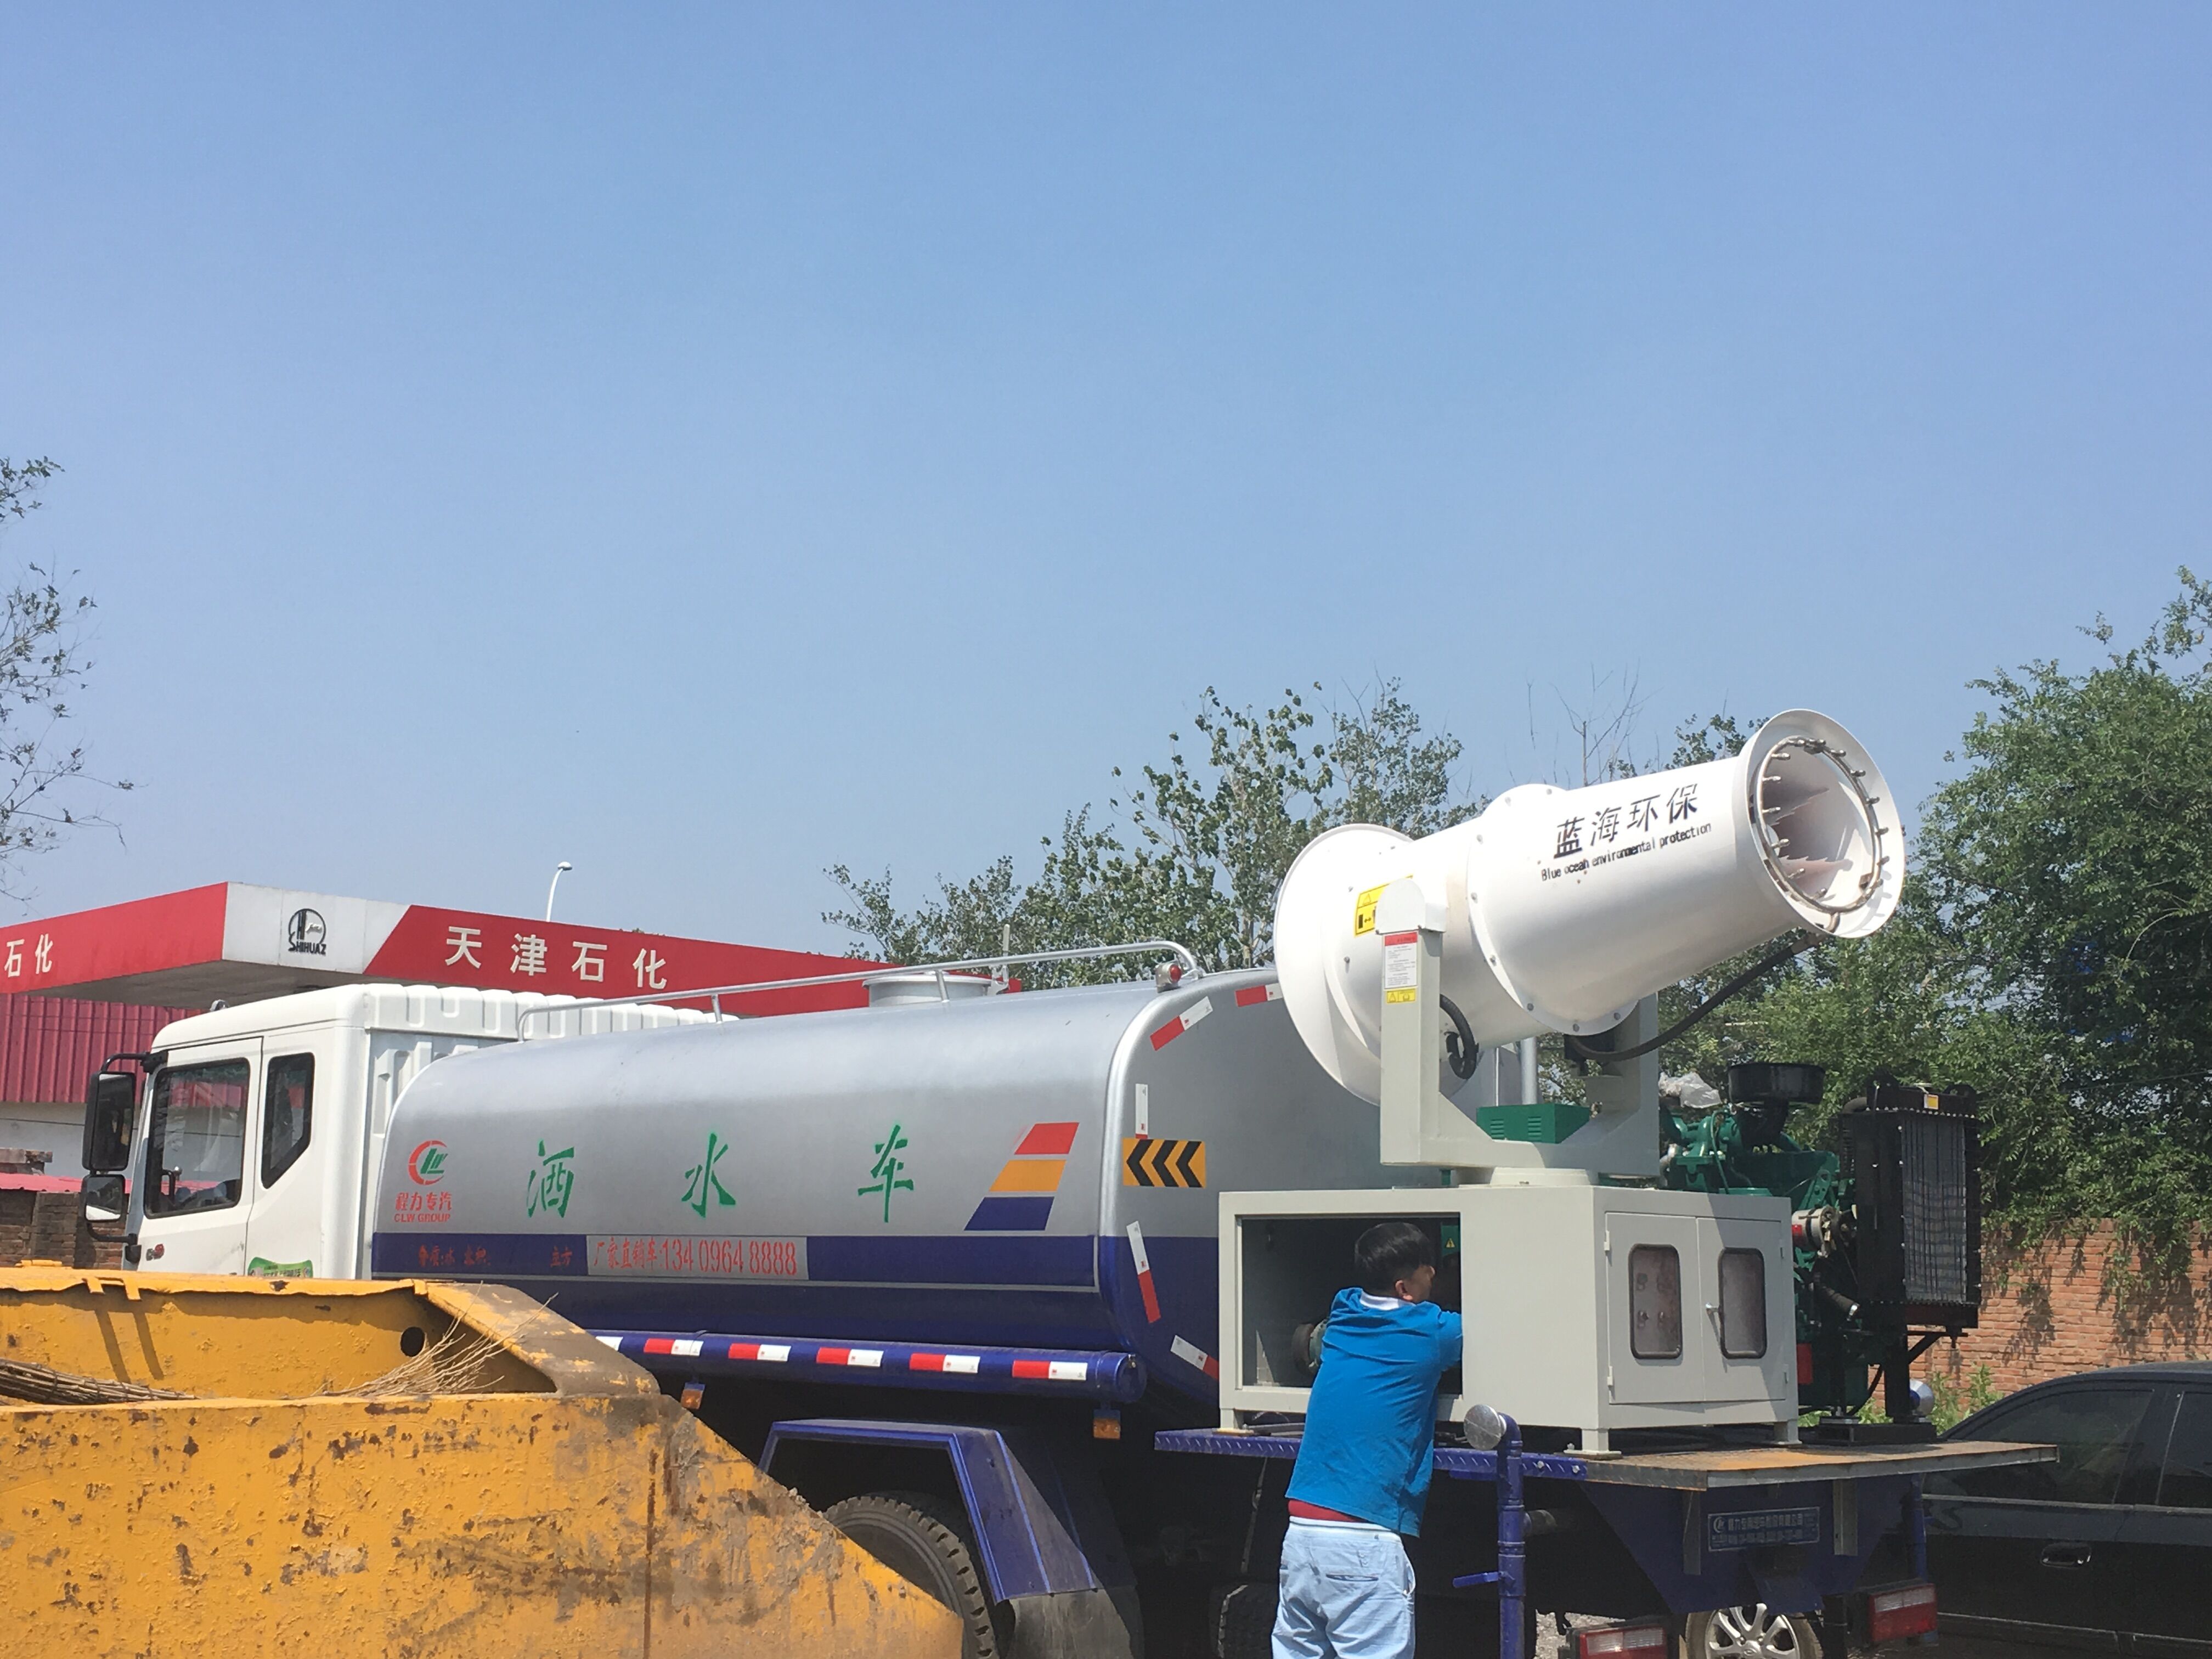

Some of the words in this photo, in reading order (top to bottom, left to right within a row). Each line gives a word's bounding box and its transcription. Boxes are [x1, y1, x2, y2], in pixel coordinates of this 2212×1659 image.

[1553, 783, 1698, 859] 蓝海环保
[1541, 865, 1562, 881] Blue
[1564, 859, 1589, 875] ocean
[1659, 822, 1712, 849] protection
[4, 933, 53, 978] 石化
[445, 926, 668, 989] 天津石化
[395, 1191, 452, 1211] 程力专汽
[417, 1212, 451, 1223] GROUP
